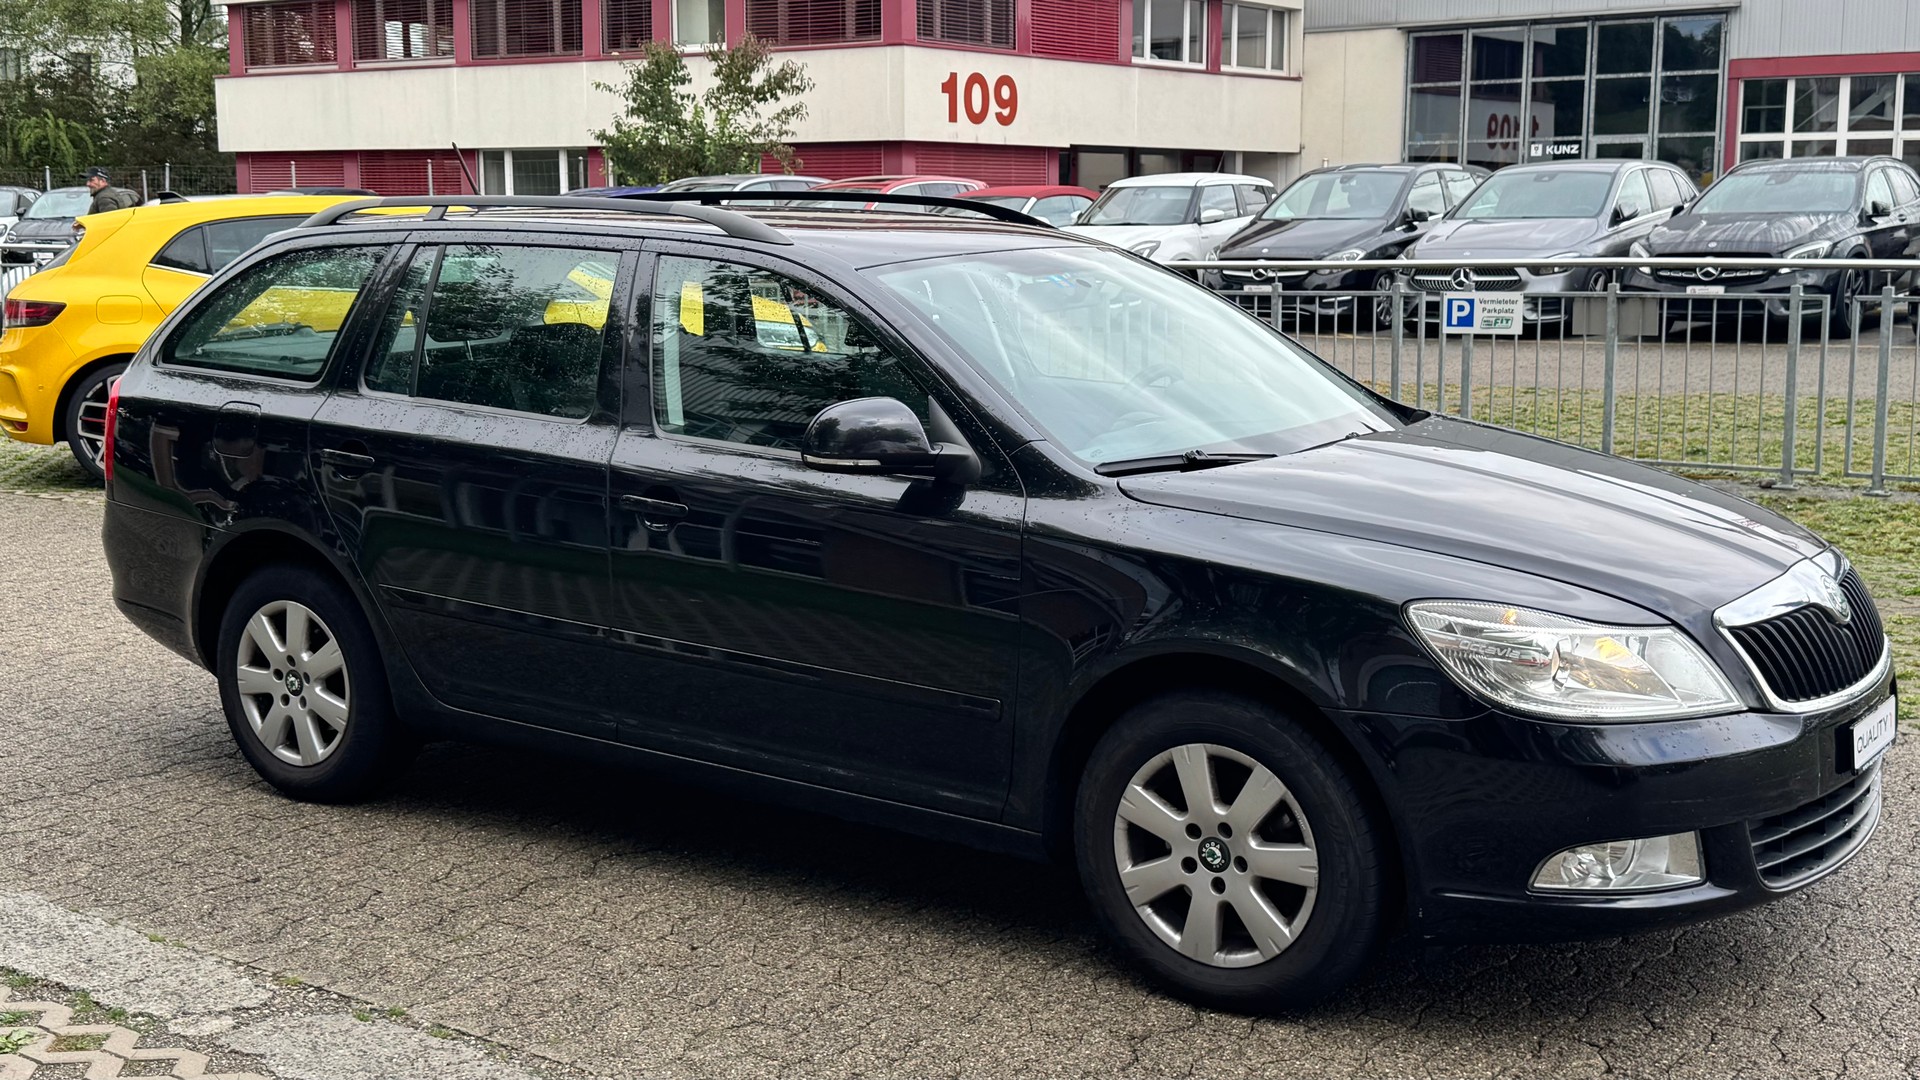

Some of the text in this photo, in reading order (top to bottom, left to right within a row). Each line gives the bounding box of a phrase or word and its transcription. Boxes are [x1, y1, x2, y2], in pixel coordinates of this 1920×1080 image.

[941, 72, 1018, 126] 109
[1545, 144, 1580, 155] KUNZ
[1451, 300, 1471, 326] P
[1482, 307, 1514, 315] Parkplatz
[1494, 318, 1512, 327] FIT
[1459, 640, 1520, 659] Octavia
[1857, 714, 1888, 753] QUALITY
